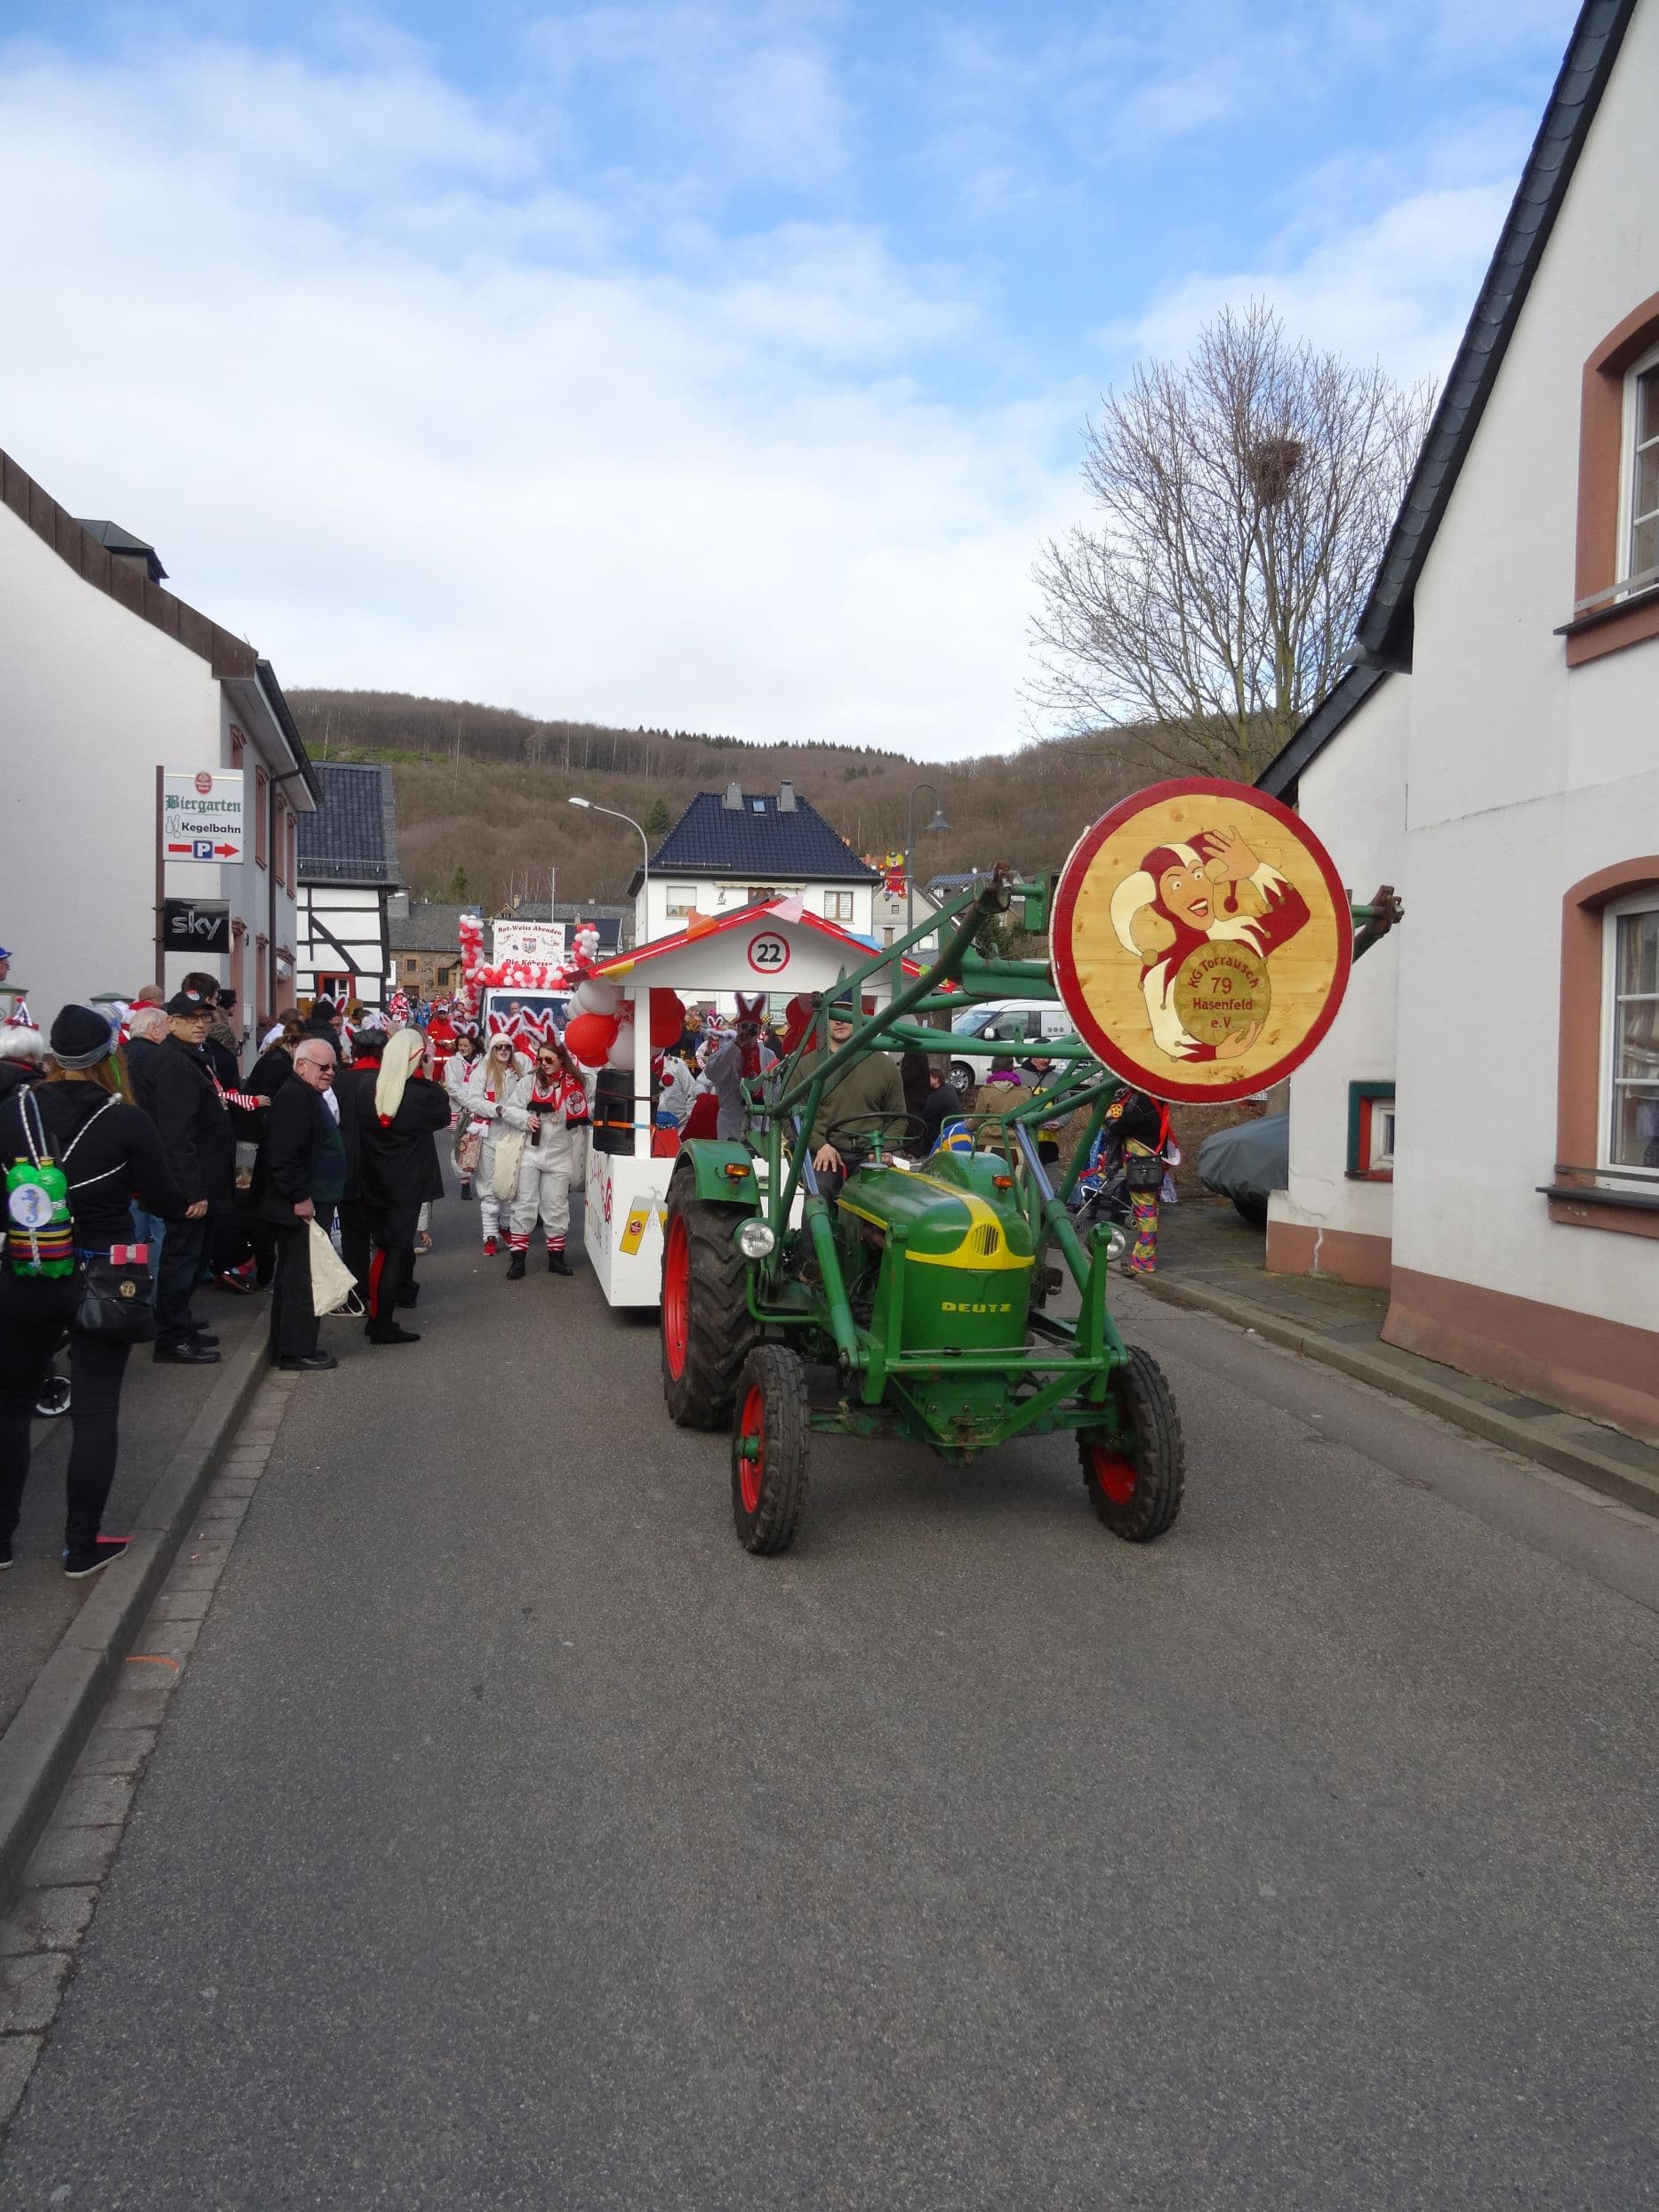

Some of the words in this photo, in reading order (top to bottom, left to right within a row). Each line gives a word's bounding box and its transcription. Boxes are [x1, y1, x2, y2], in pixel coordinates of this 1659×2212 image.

[165, 795, 241, 813] Biergarten
[181, 822, 241, 834] Kegelbahn
[197, 842, 211, 857] P
[172, 910, 222, 941] sky
[757, 943, 782, 963] 22
[1188, 969, 1203, 989] KG
[1198, 957, 1259, 990] Torrausch
[1211, 976, 1232, 994] 79
[1193, 998, 1252, 1011] Hasenfeld
[942, 1302, 1011, 1312] DEUTZ
